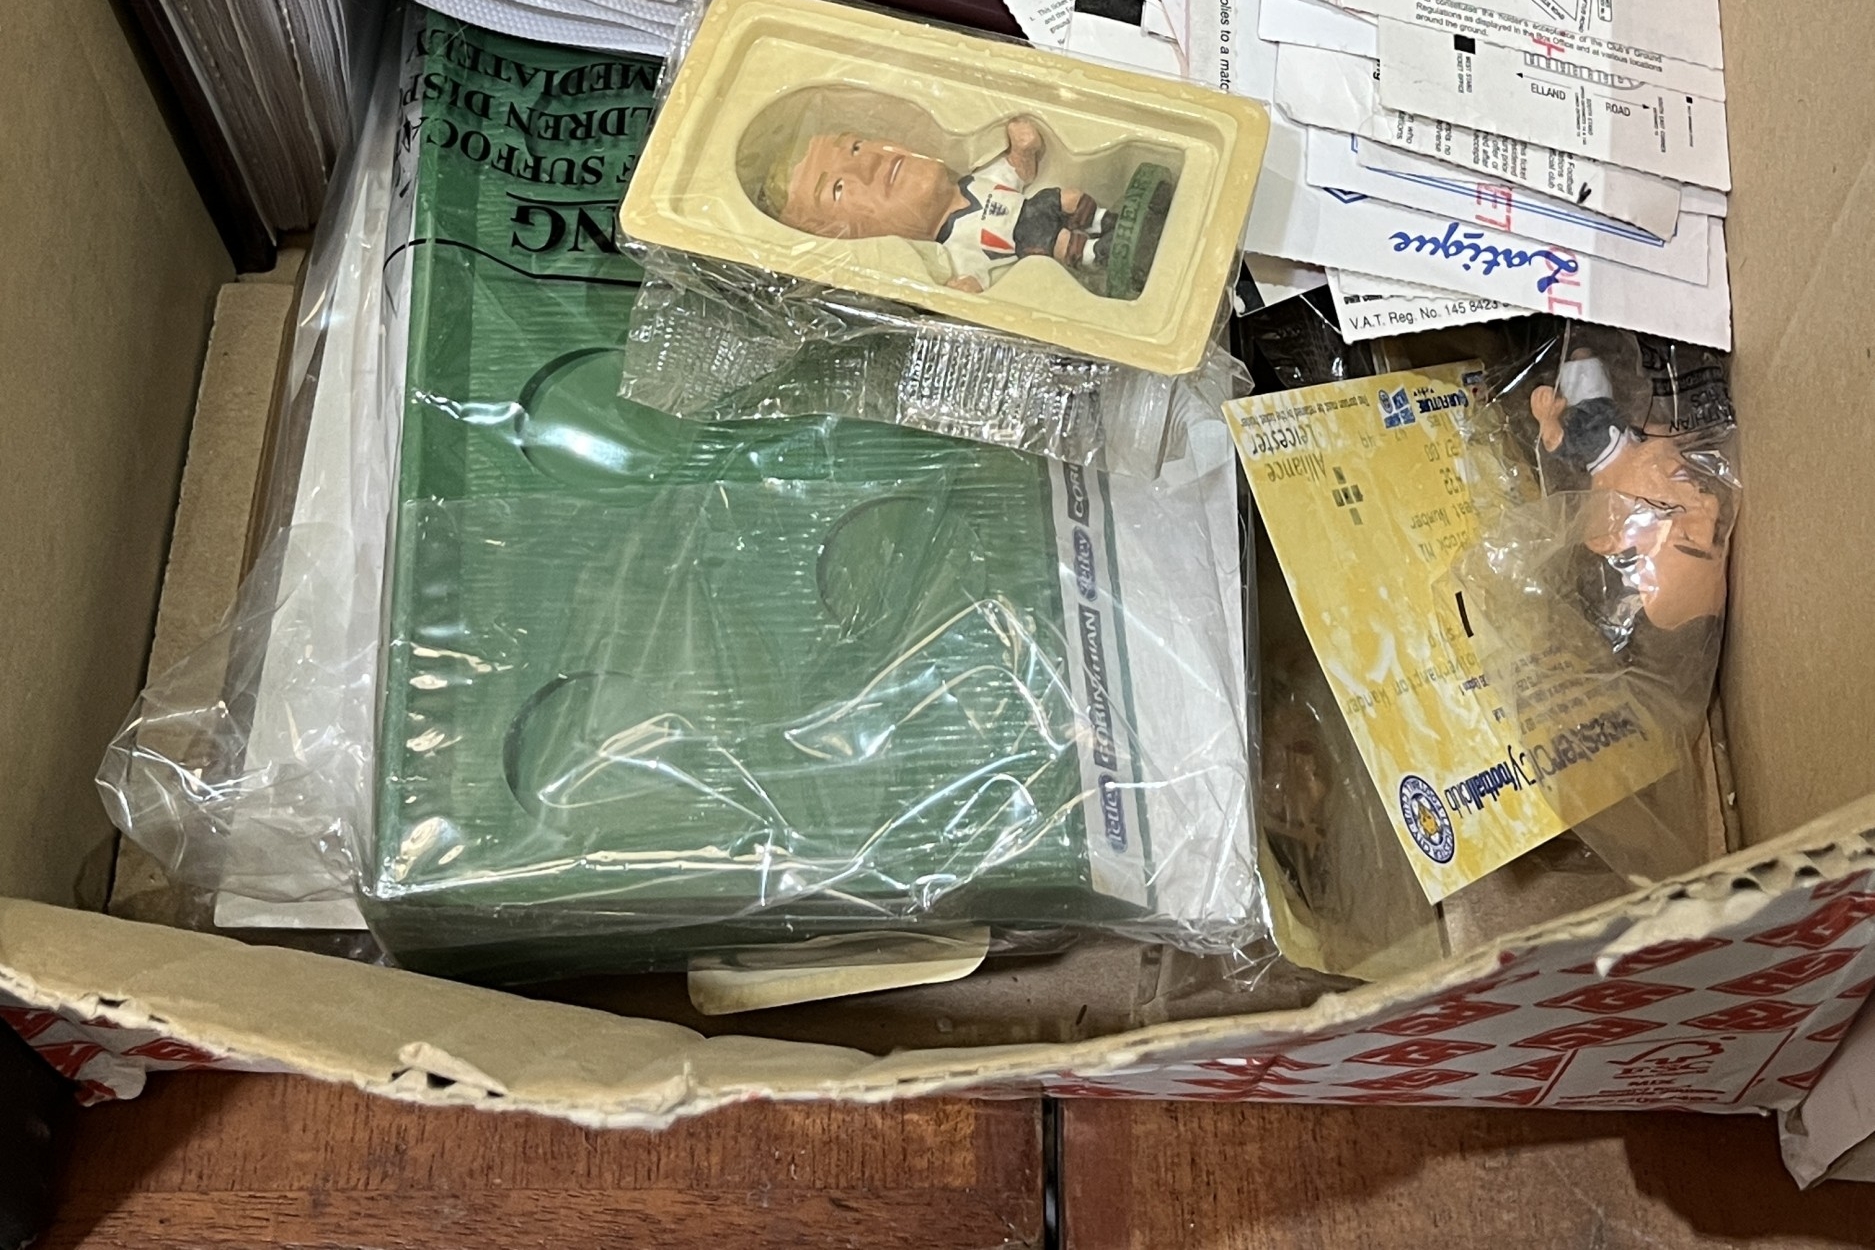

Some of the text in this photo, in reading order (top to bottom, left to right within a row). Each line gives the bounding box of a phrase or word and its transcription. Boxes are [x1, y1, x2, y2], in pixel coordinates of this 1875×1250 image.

[1221, 31, 1230, 42] to
[1416, 13, 1488, 37] around the ground.
[1416, 2, 1462, 24] Regulations
[1464, 16, 1473, 24] as
[1475, 16, 1511, 33] displayed
[1514, 24, 1520, 32] in
[1522, 26, 1535, 37] the
[1553, 33, 1575, 48] Office
[1576, 41, 1590, 52] and
[1630, 56, 1663, 72] locations
[406, 28, 660, 97] MEDIATELY
[1220, 46, 1229, 54] a
[1220, 58, 1231, 90] matc
[403, 72, 654, 142] LDREN DISP
[1531, 83, 1631, 117] ELLAND ROAD
[1500, 156, 1508, 173] prior
[1566, 162, 1575, 195] Football
[1475, 182, 1513, 232] ET
[511, 204, 621, 253] NG
[1349, 311, 1386, 330] V.A.T.
[1389, 309, 1417, 326] Reg.
[1420, 306, 1441, 320] No.
[1444, 302, 1466, 316] 145
[1253, 424, 1312, 454] Leicester
[1267, 453, 1328, 482] Alliance
[1064, 464, 1086, 518] CORI
